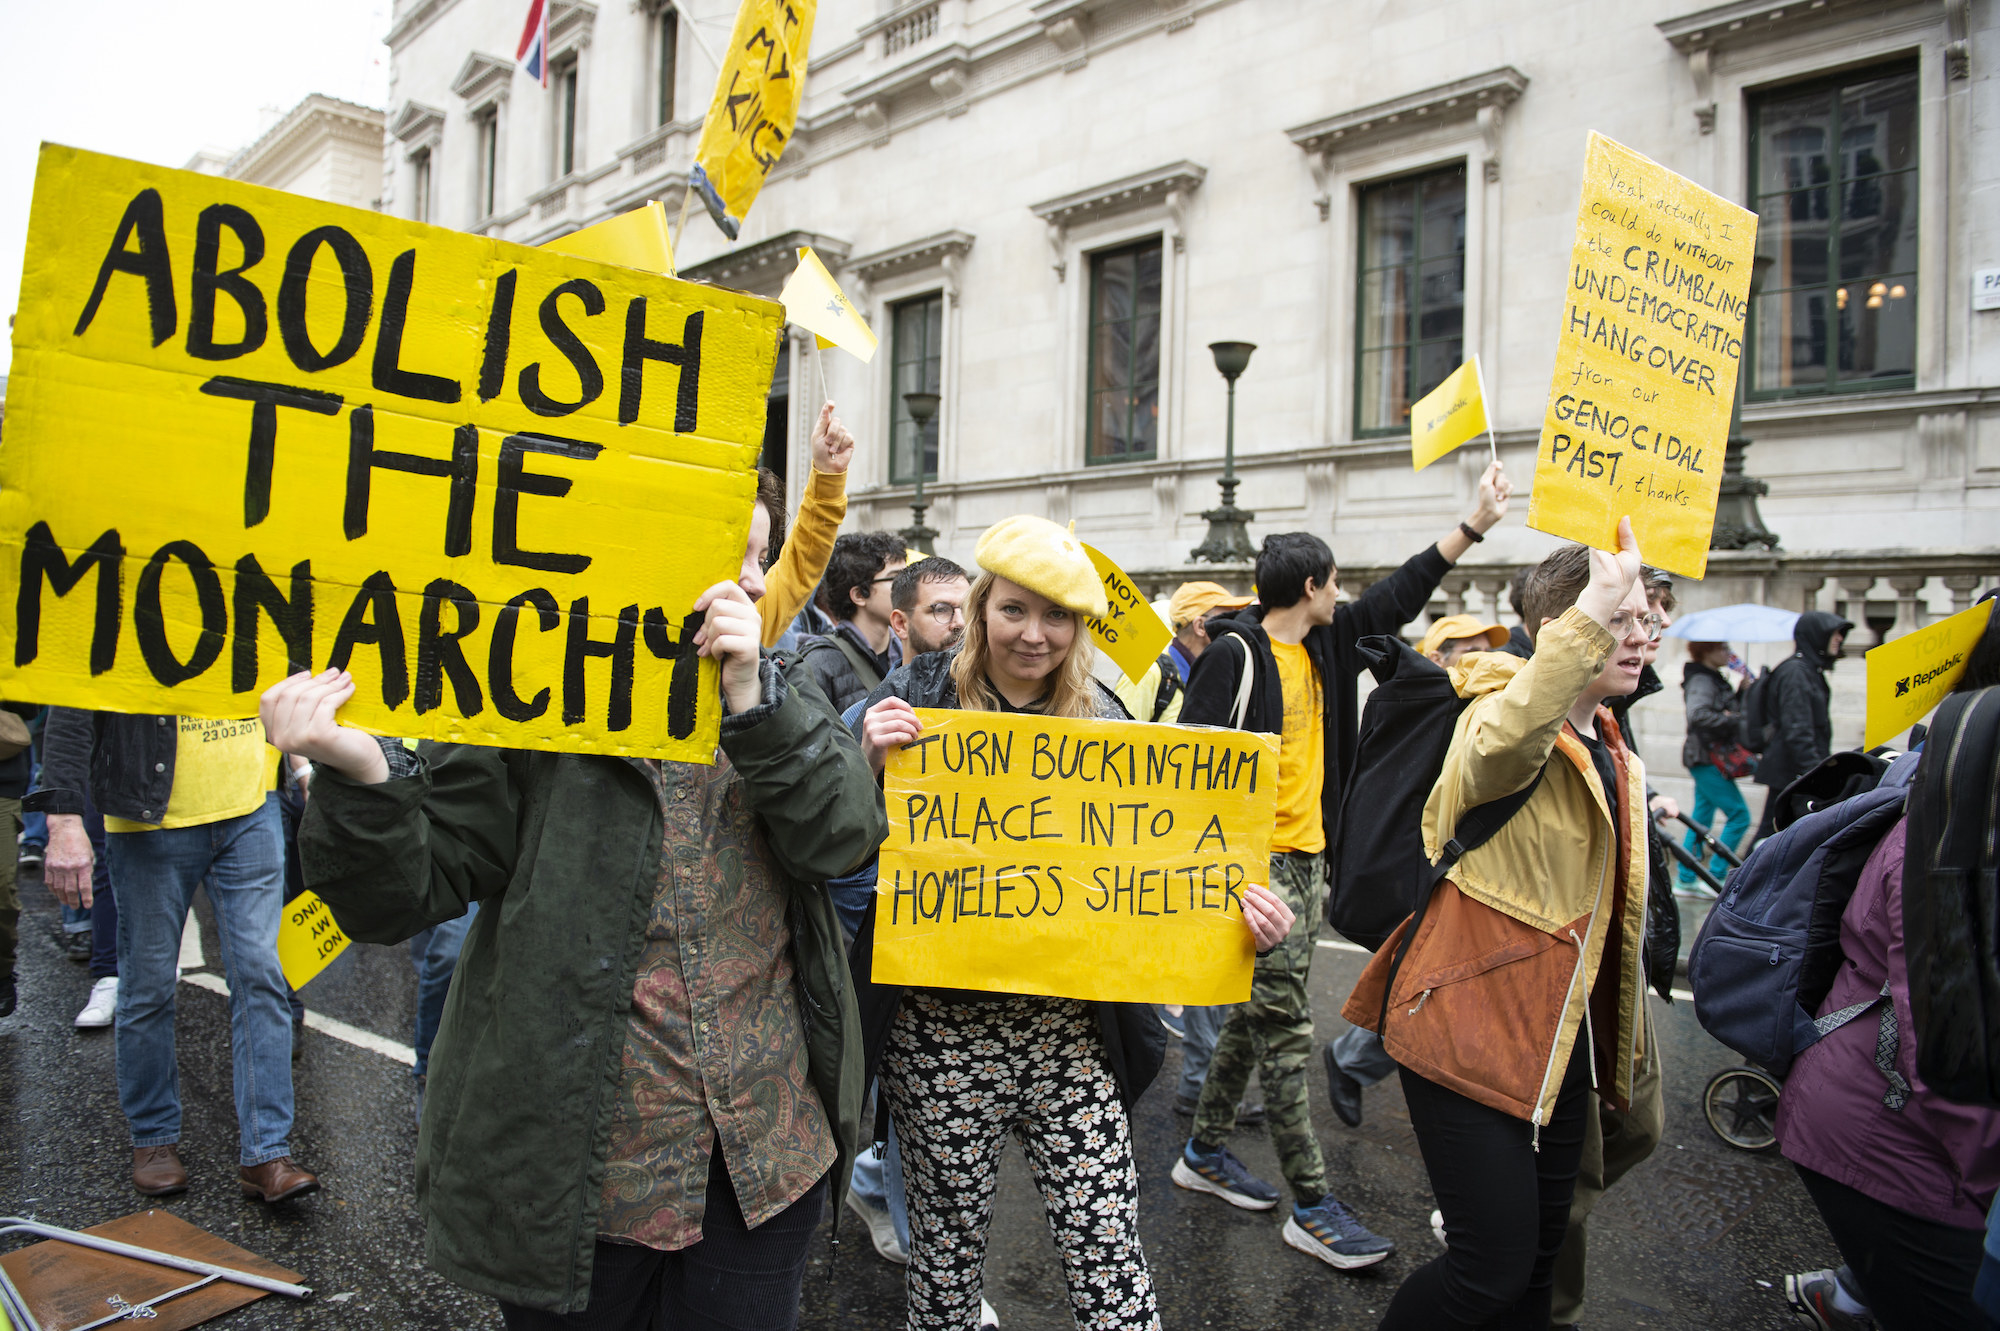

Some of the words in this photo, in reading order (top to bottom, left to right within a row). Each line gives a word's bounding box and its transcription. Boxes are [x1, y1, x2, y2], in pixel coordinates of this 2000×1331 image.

[746, 27, 789, 81] MY
[1592, 202, 1639, 231] could
[1646, 223, 1662, 243] do
[1674, 238, 1735, 274] WITHOUT
[1720, 224, 1735, 241] I
[1588, 232, 1613, 258] the
[1623, 245, 1748, 321] CRUMBLING
[74, 187, 705, 436] ABOLISH
[1574, 264, 1742, 359] UNDEMOCRATIC
[1570, 305, 1716, 396] HANGOVER
[1632, 387, 1660, 404] our
[1551, 434, 1624, 493] PAST,
[1555, 394, 1704, 473] GENOCIDAL
[200, 375, 607, 576] THE
[1104, 572, 1140, 609] NOT
[14, 520, 706, 741] MONARCHY
[1086, 617, 1120, 644] ING
[1912, 652, 1964, 689] Republic
[181, 723, 203, 733] PARK
[901, 730, 1014, 777] TURN
[1031, 732, 1260, 794] BUCKINGHAM
[907, 792, 1063, 844] PALACE
[1081, 801, 1174, 847] INTO
[1194, 814, 1228, 853] A
[292, 897, 323, 926] KING
[892, 864, 1064, 925] HOMELESS
[1086, 863, 1246, 917] SHELTER
[311, 916, 331, 940] MY
[317, 930, 343, 960] NOT
